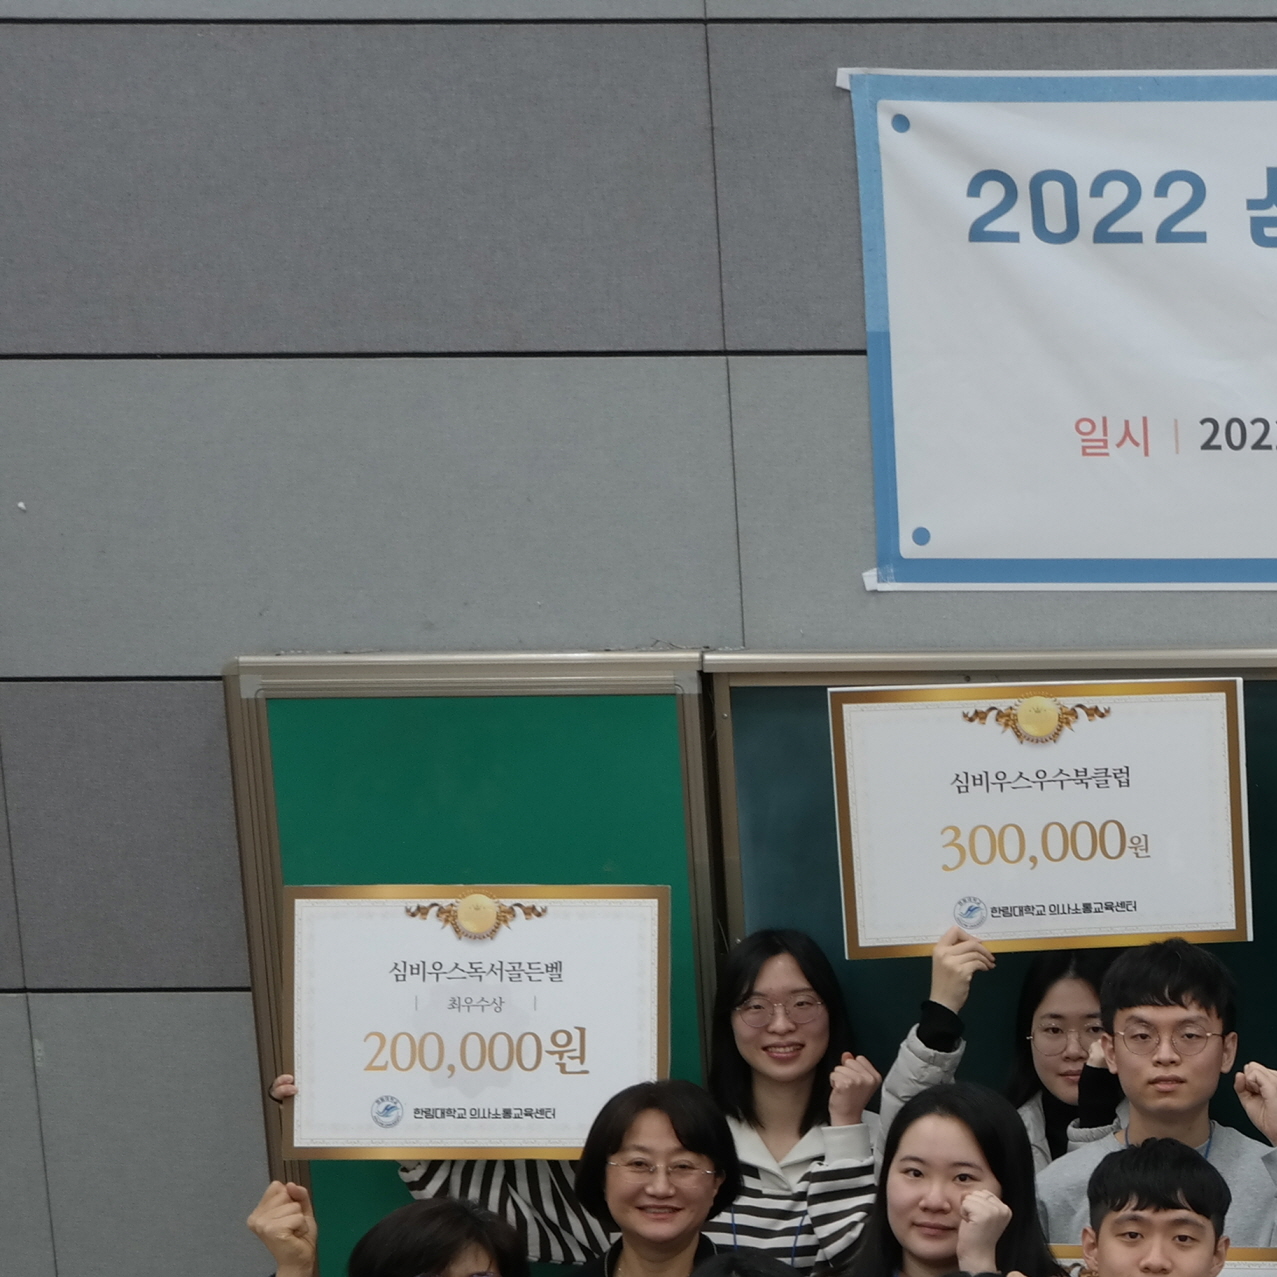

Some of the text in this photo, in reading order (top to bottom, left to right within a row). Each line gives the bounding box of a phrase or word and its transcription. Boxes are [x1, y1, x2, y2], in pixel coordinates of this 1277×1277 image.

[966, 168, 1209, 246] 2022
[1074, 415, 1152, 457] 일시
[949, 765, 1131, 795] 심비우스우수북클럽
[940, 819, 1152, 872] 300,000원
[989, 903, 1046, 919] 한림대학교
[1048, 899, 1138, 917] 의사소통교육센터
[388, 959, 564, 984] 심비우스독서골든벨
[446, 995, 505, 1013] 최우수상
[363, 1026, 590, 1079] 200,000원
[412, 1106, 467, 1120] 한림대학교
[468, 1106, 557, 1120] 의사소통교육센터
